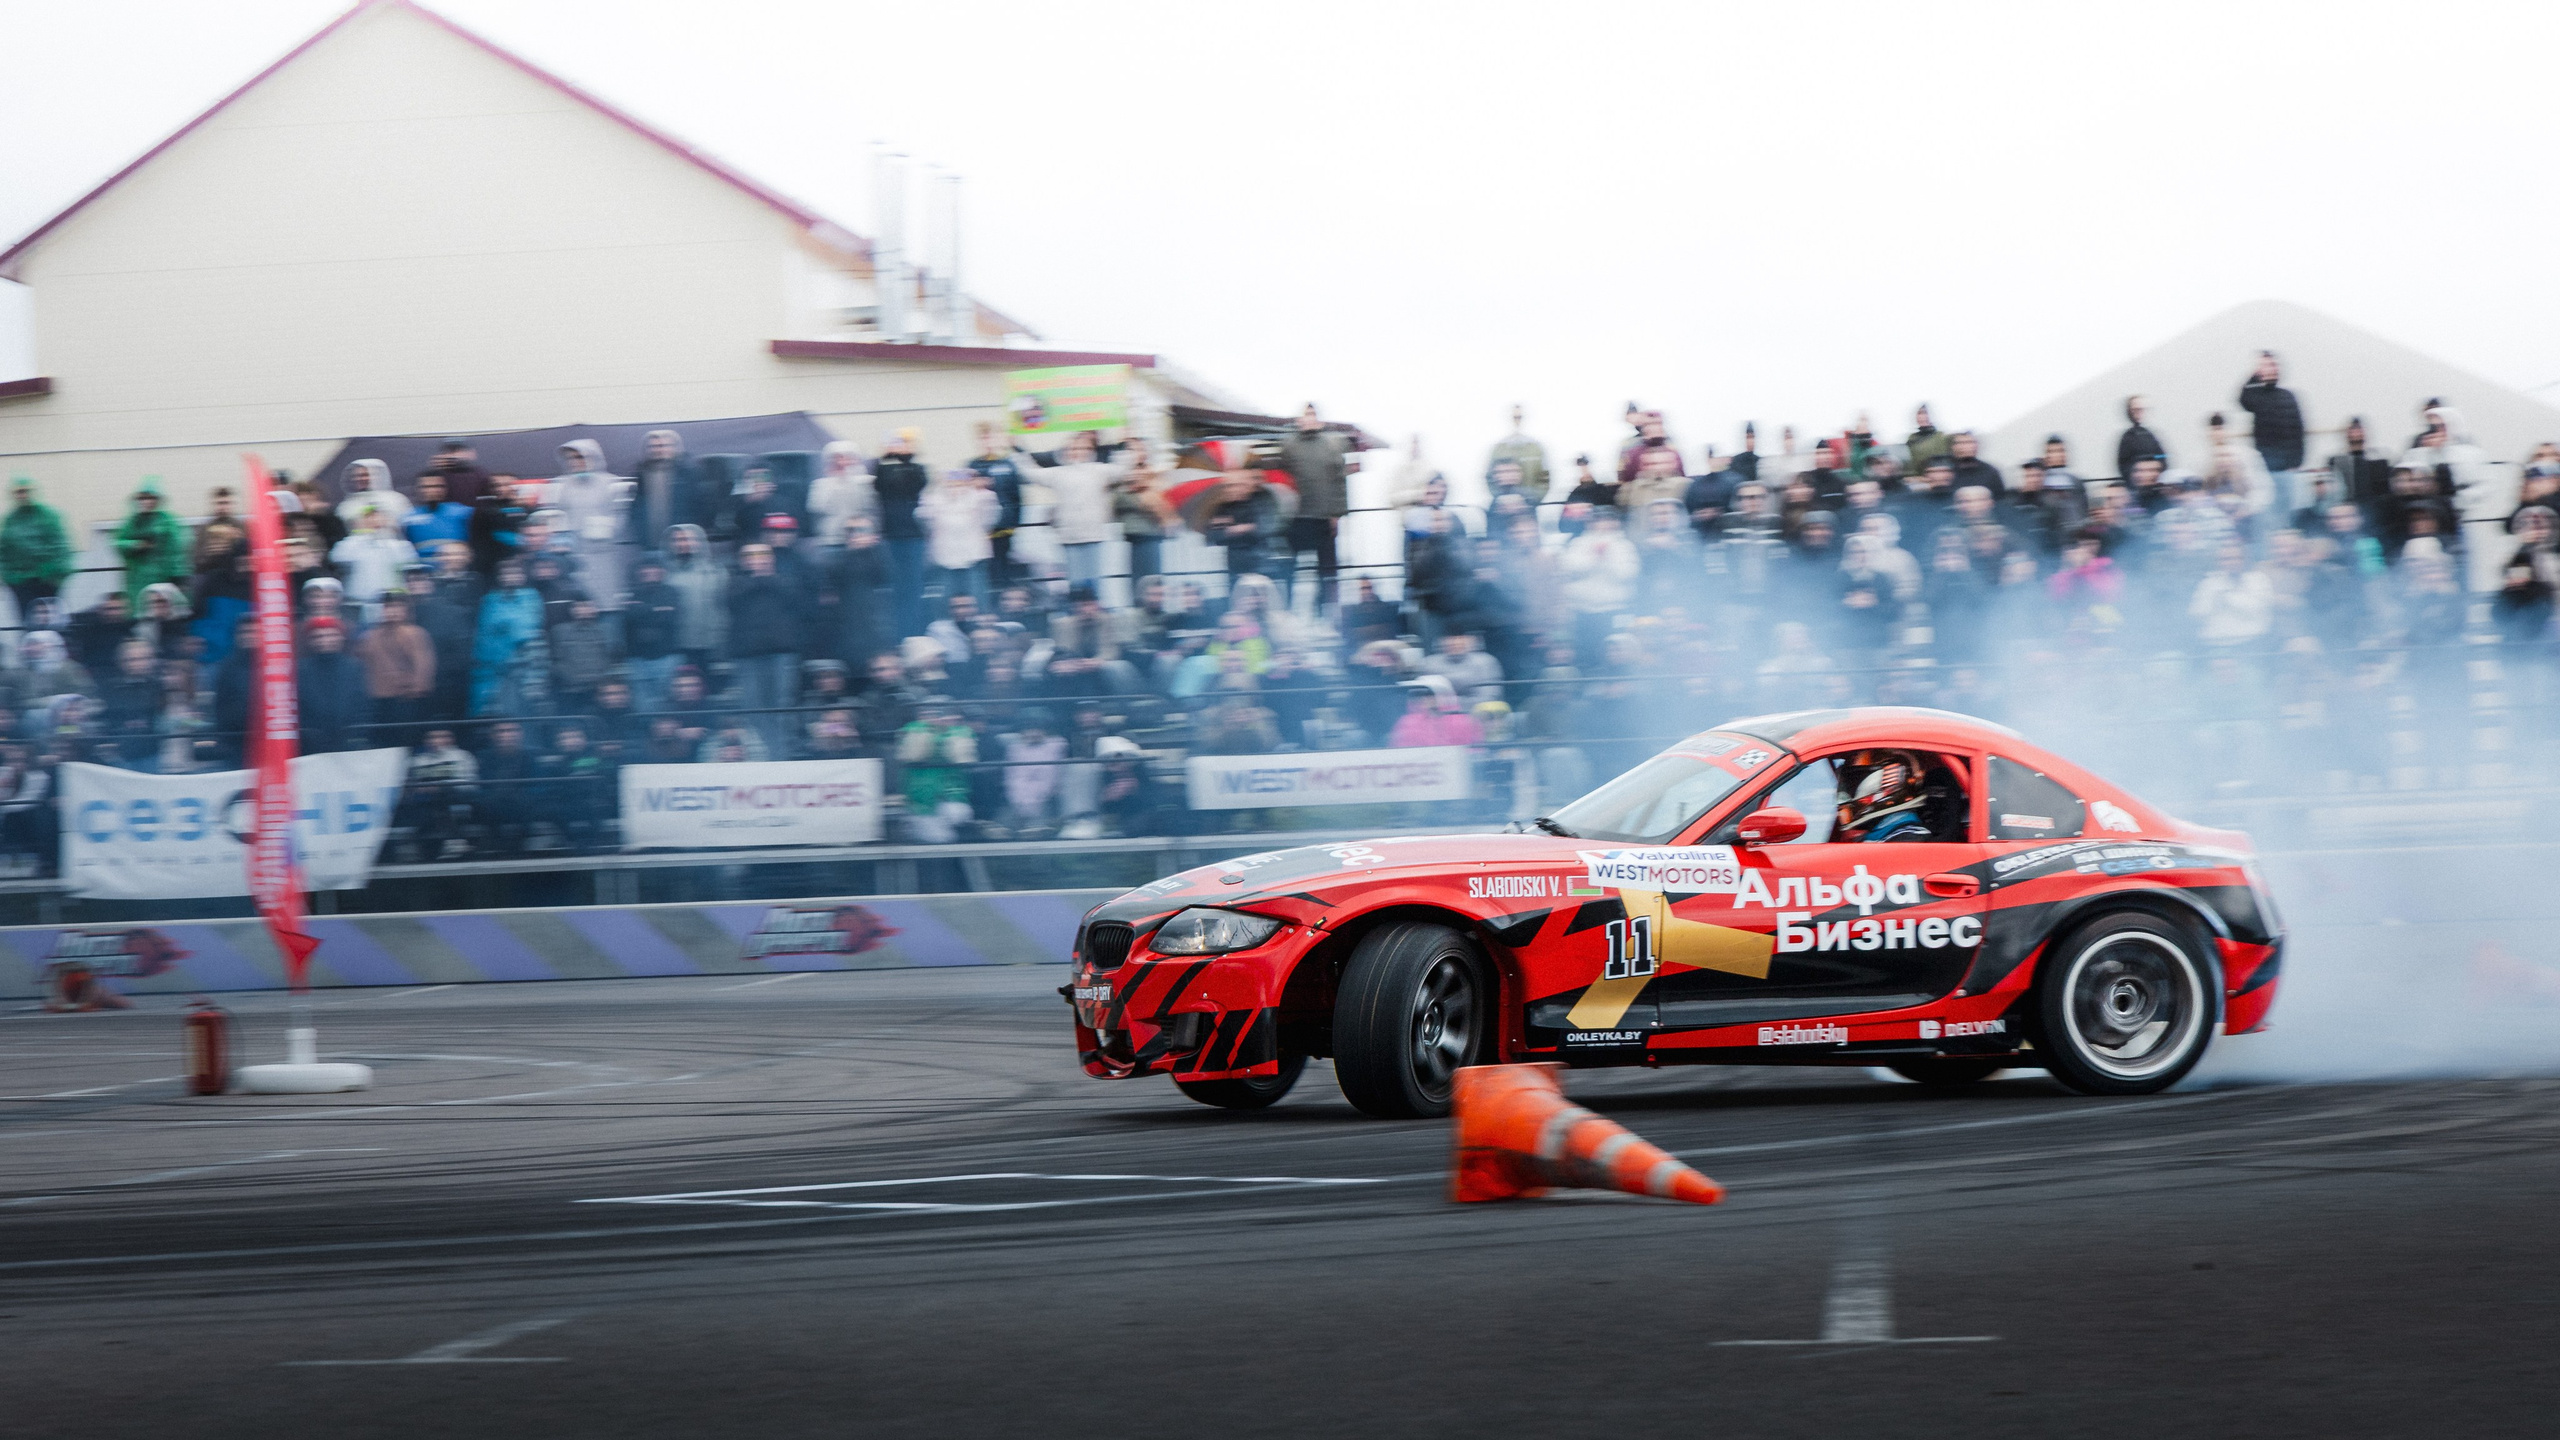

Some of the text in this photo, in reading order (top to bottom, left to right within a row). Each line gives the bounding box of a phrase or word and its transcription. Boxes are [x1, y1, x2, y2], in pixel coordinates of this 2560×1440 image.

[1630, 850, 1728, 861] Valvoline
[1595, 863, 1733, 885] WESTMOTORS
[1468, 876, 1563, 898] SLABODSKI V.
[1733, 864, 1921, 916] Альфа
[1776, 911, 1983, 953] Бизнес
[1604, 914, 1655, 980] 11
[1566, 1031, 1642, 1042] OKLEYKA.BY
